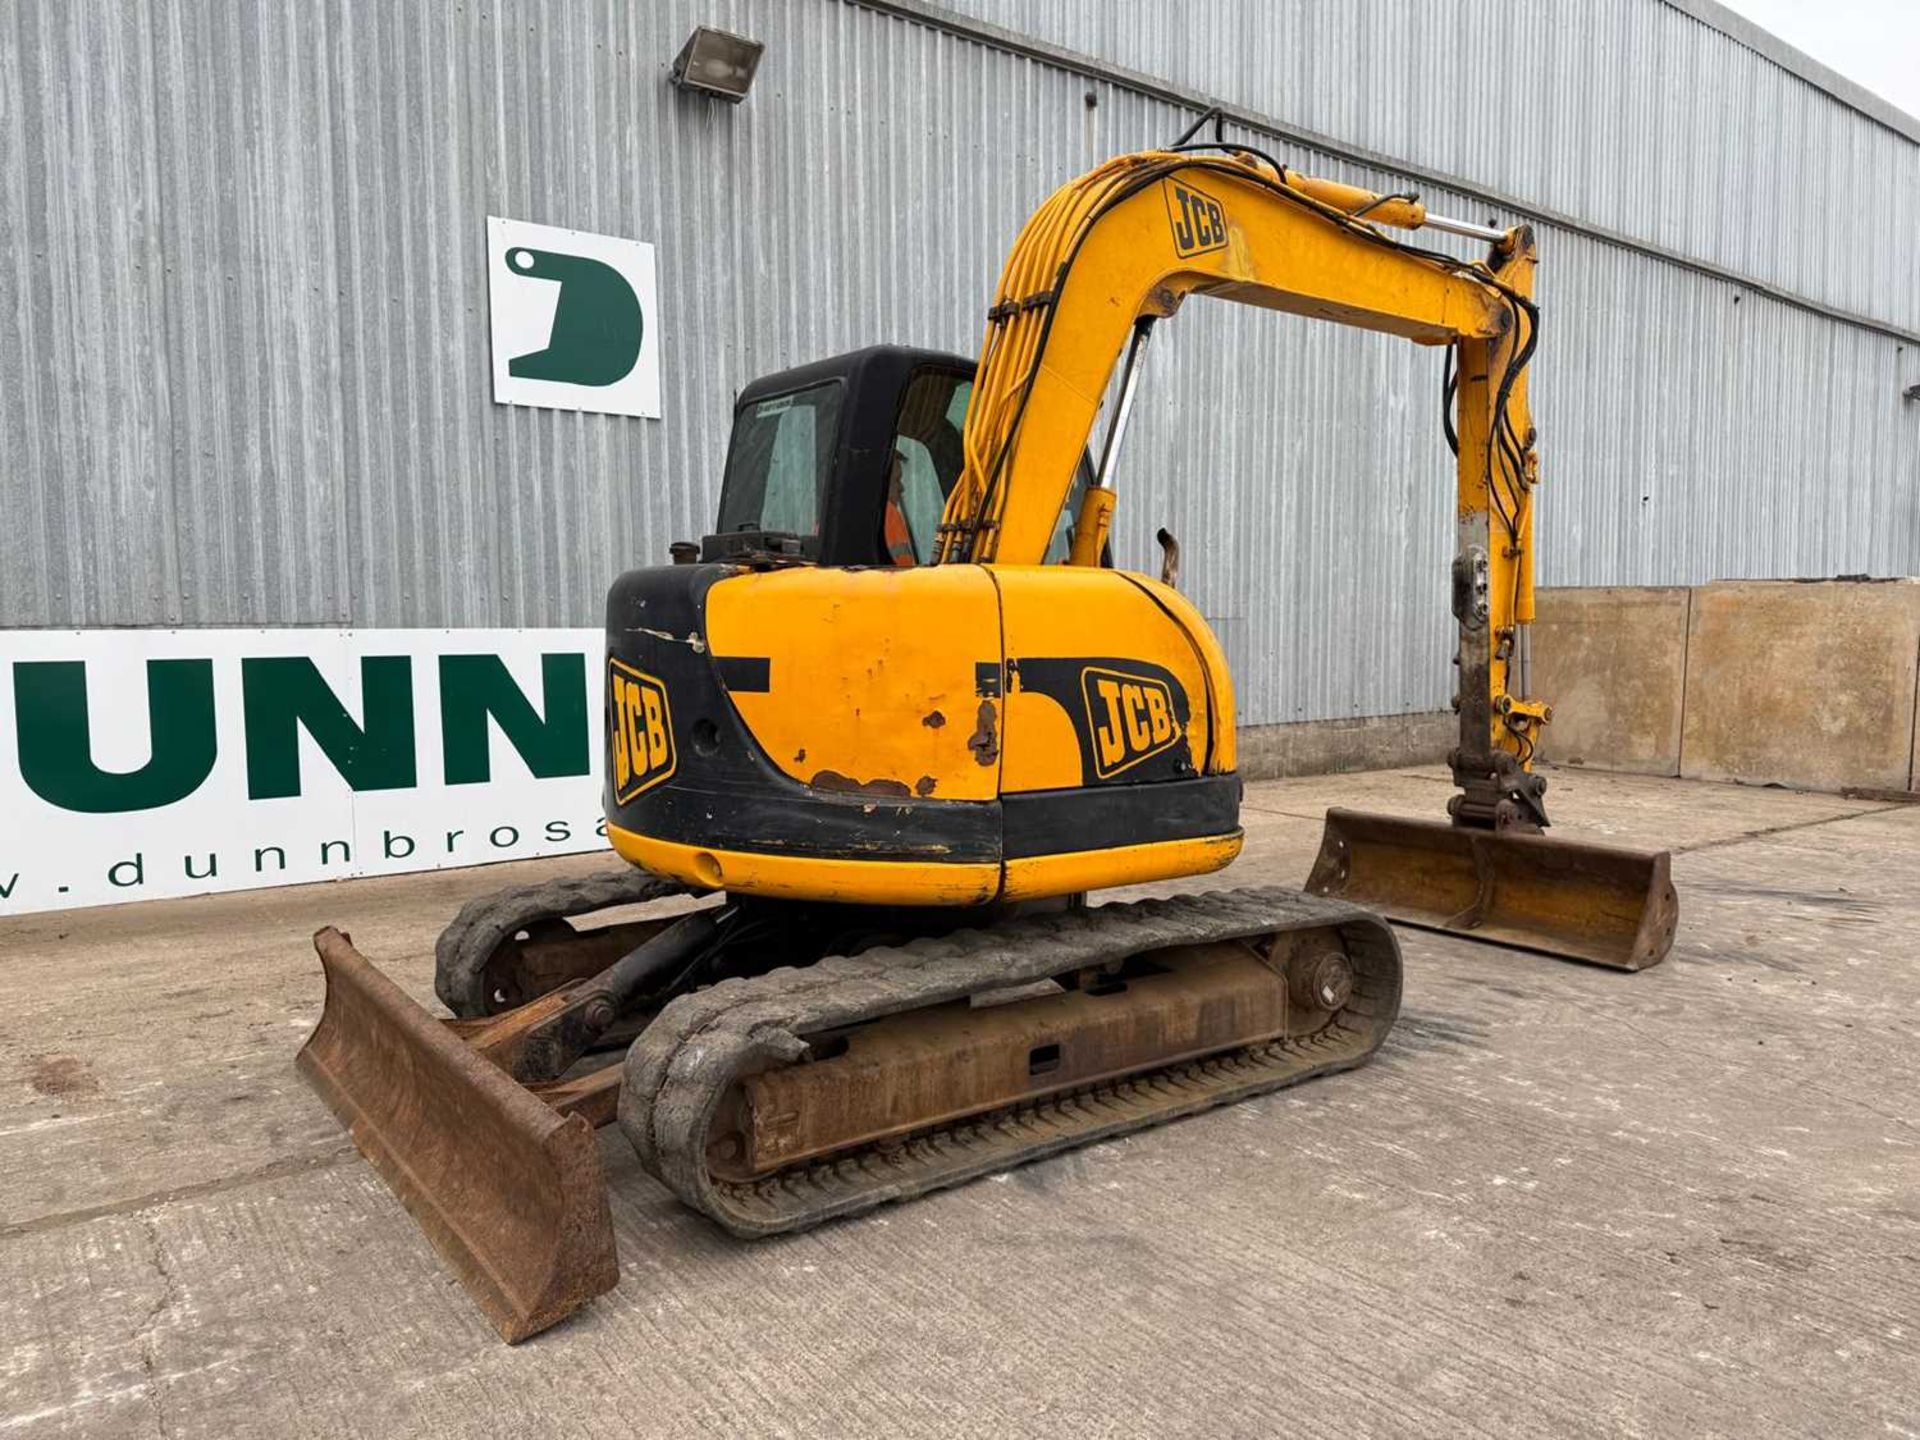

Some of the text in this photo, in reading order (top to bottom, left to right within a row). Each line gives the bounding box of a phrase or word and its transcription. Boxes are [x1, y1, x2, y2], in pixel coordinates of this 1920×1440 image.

[1175, 186, 1225, 250] JCB
[613, 674, 668, 791] JCB
[1097, 679, 1171, 767] JCB
